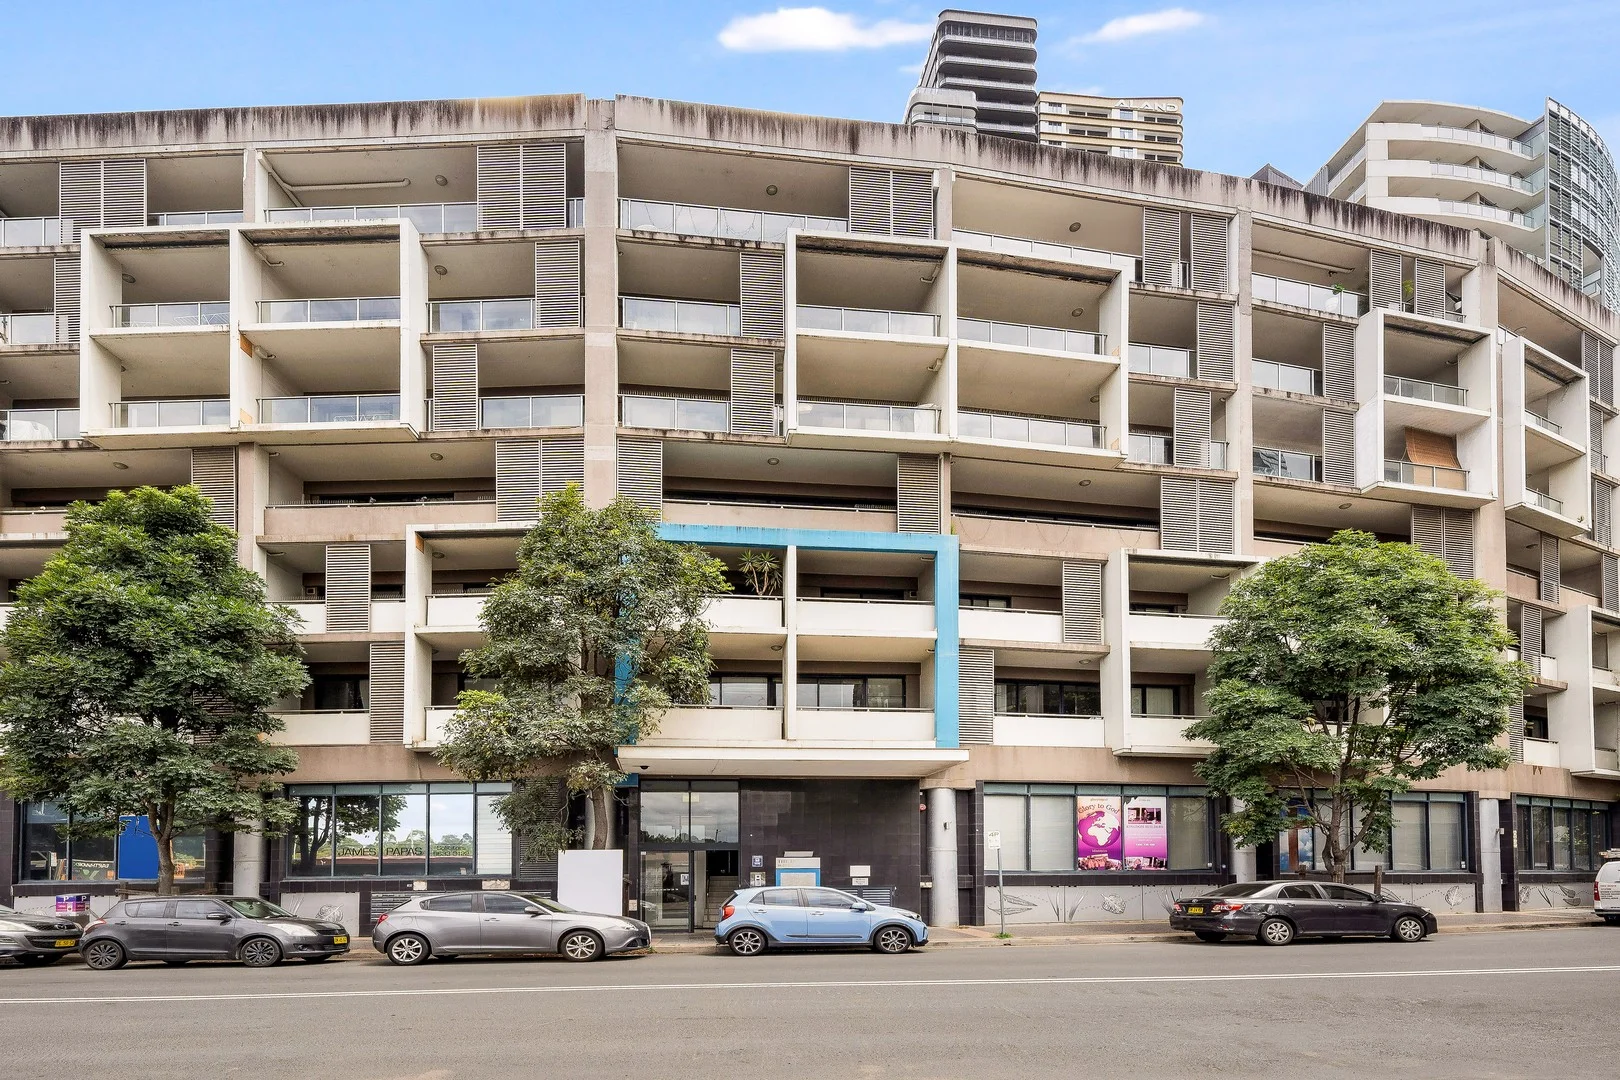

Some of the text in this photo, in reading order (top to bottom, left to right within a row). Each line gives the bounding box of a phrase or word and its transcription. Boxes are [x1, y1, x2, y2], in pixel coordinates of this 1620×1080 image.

[1115, 99, 1178, 112] ALAND
[1078, 803, 1096, 814] Glory
[1105, 804, 1121, 815] God
[337, 847, 423, 856] JAMES PAPAS
